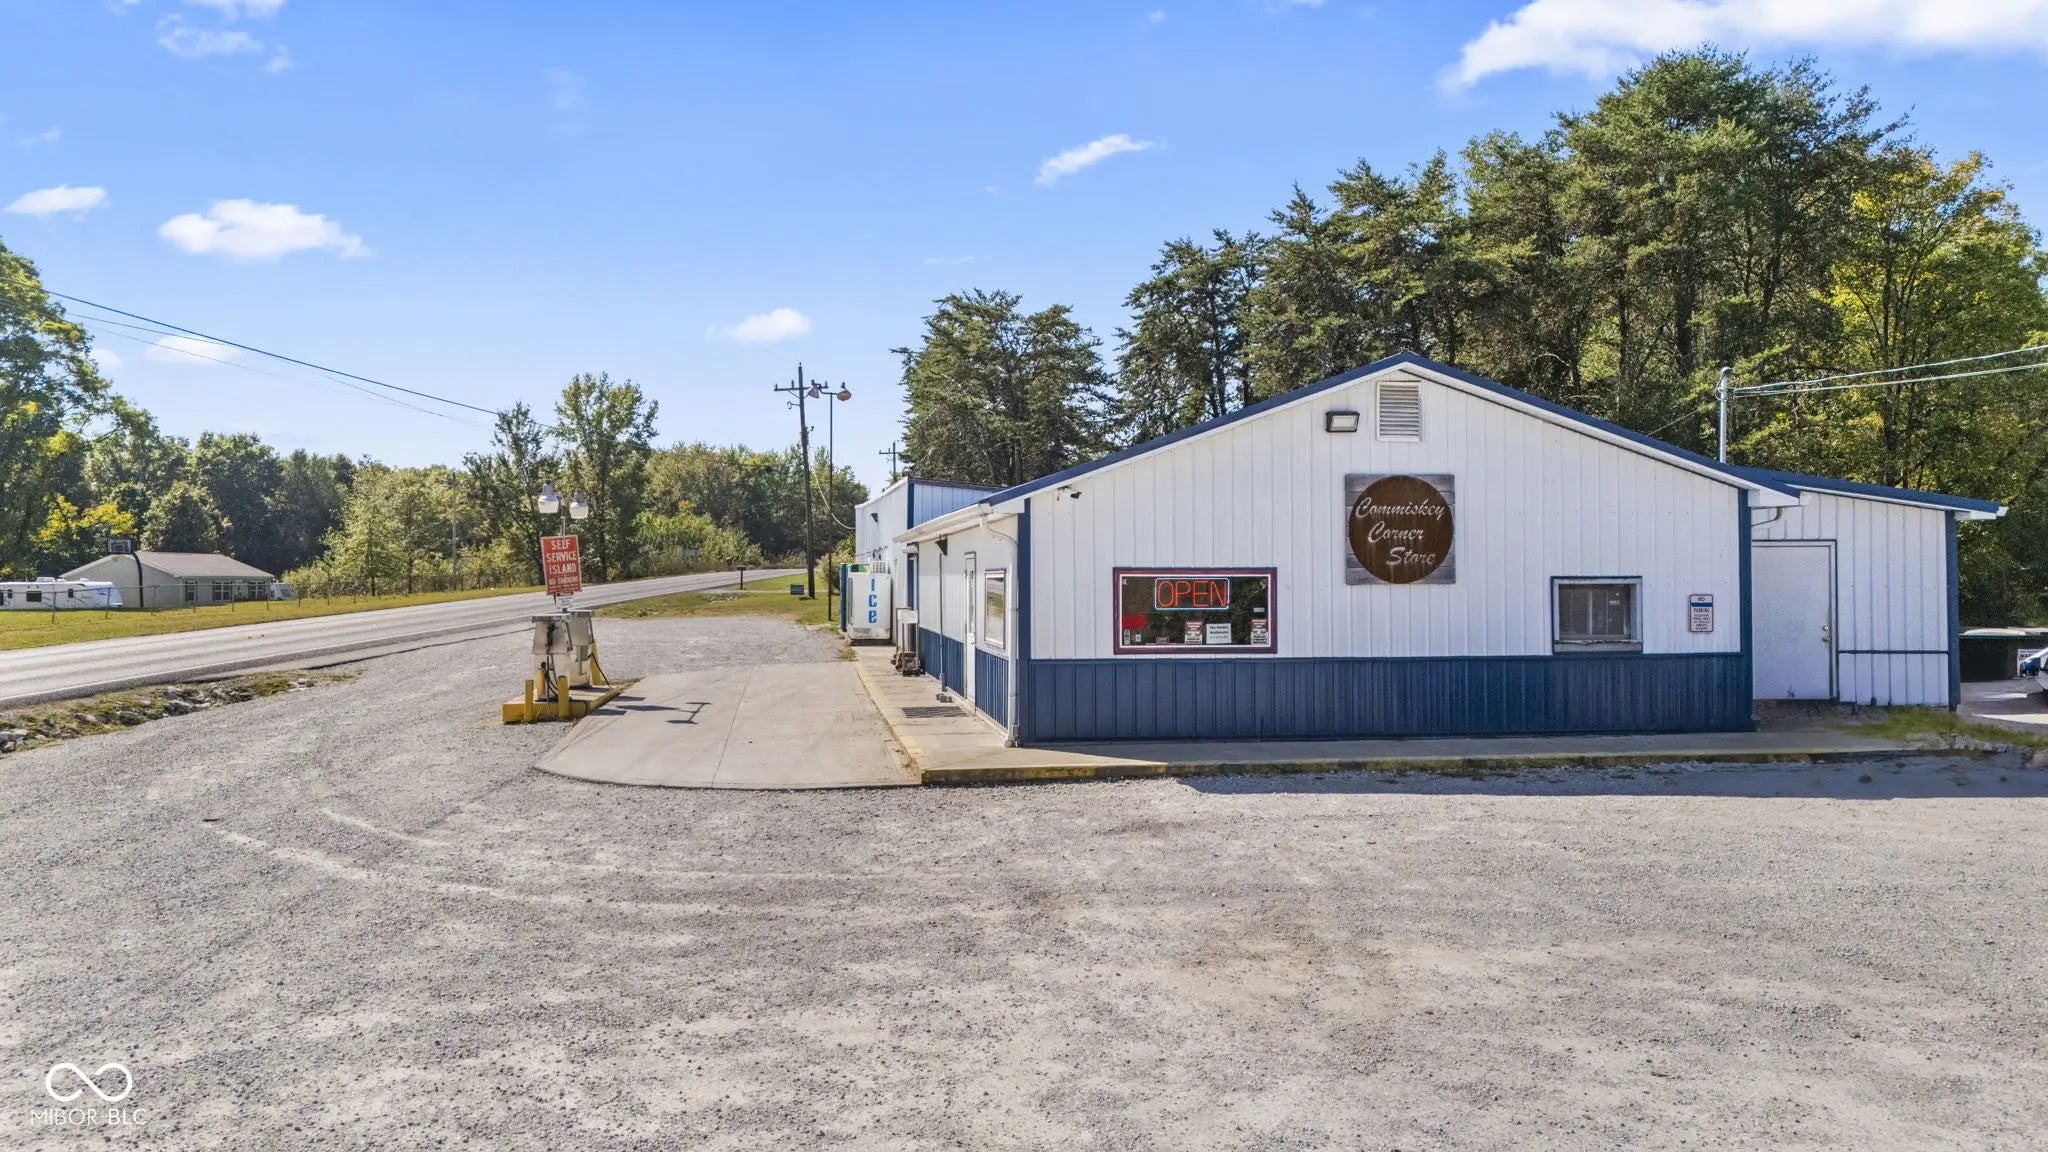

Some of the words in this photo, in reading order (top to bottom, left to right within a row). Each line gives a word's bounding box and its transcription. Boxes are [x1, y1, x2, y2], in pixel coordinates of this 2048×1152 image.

[1355, 497, 1445, 520] Commiskey
[1367, 521, 1424, 543] Corner
[551, 539, 570, 550] SELF
[546, 551, 577, 563] SERVICE
[1386, 547, 1436, 565] Store
[549, 563, 576, 575] ISLAND
[1157, 580, 1228, 607] OPEN
